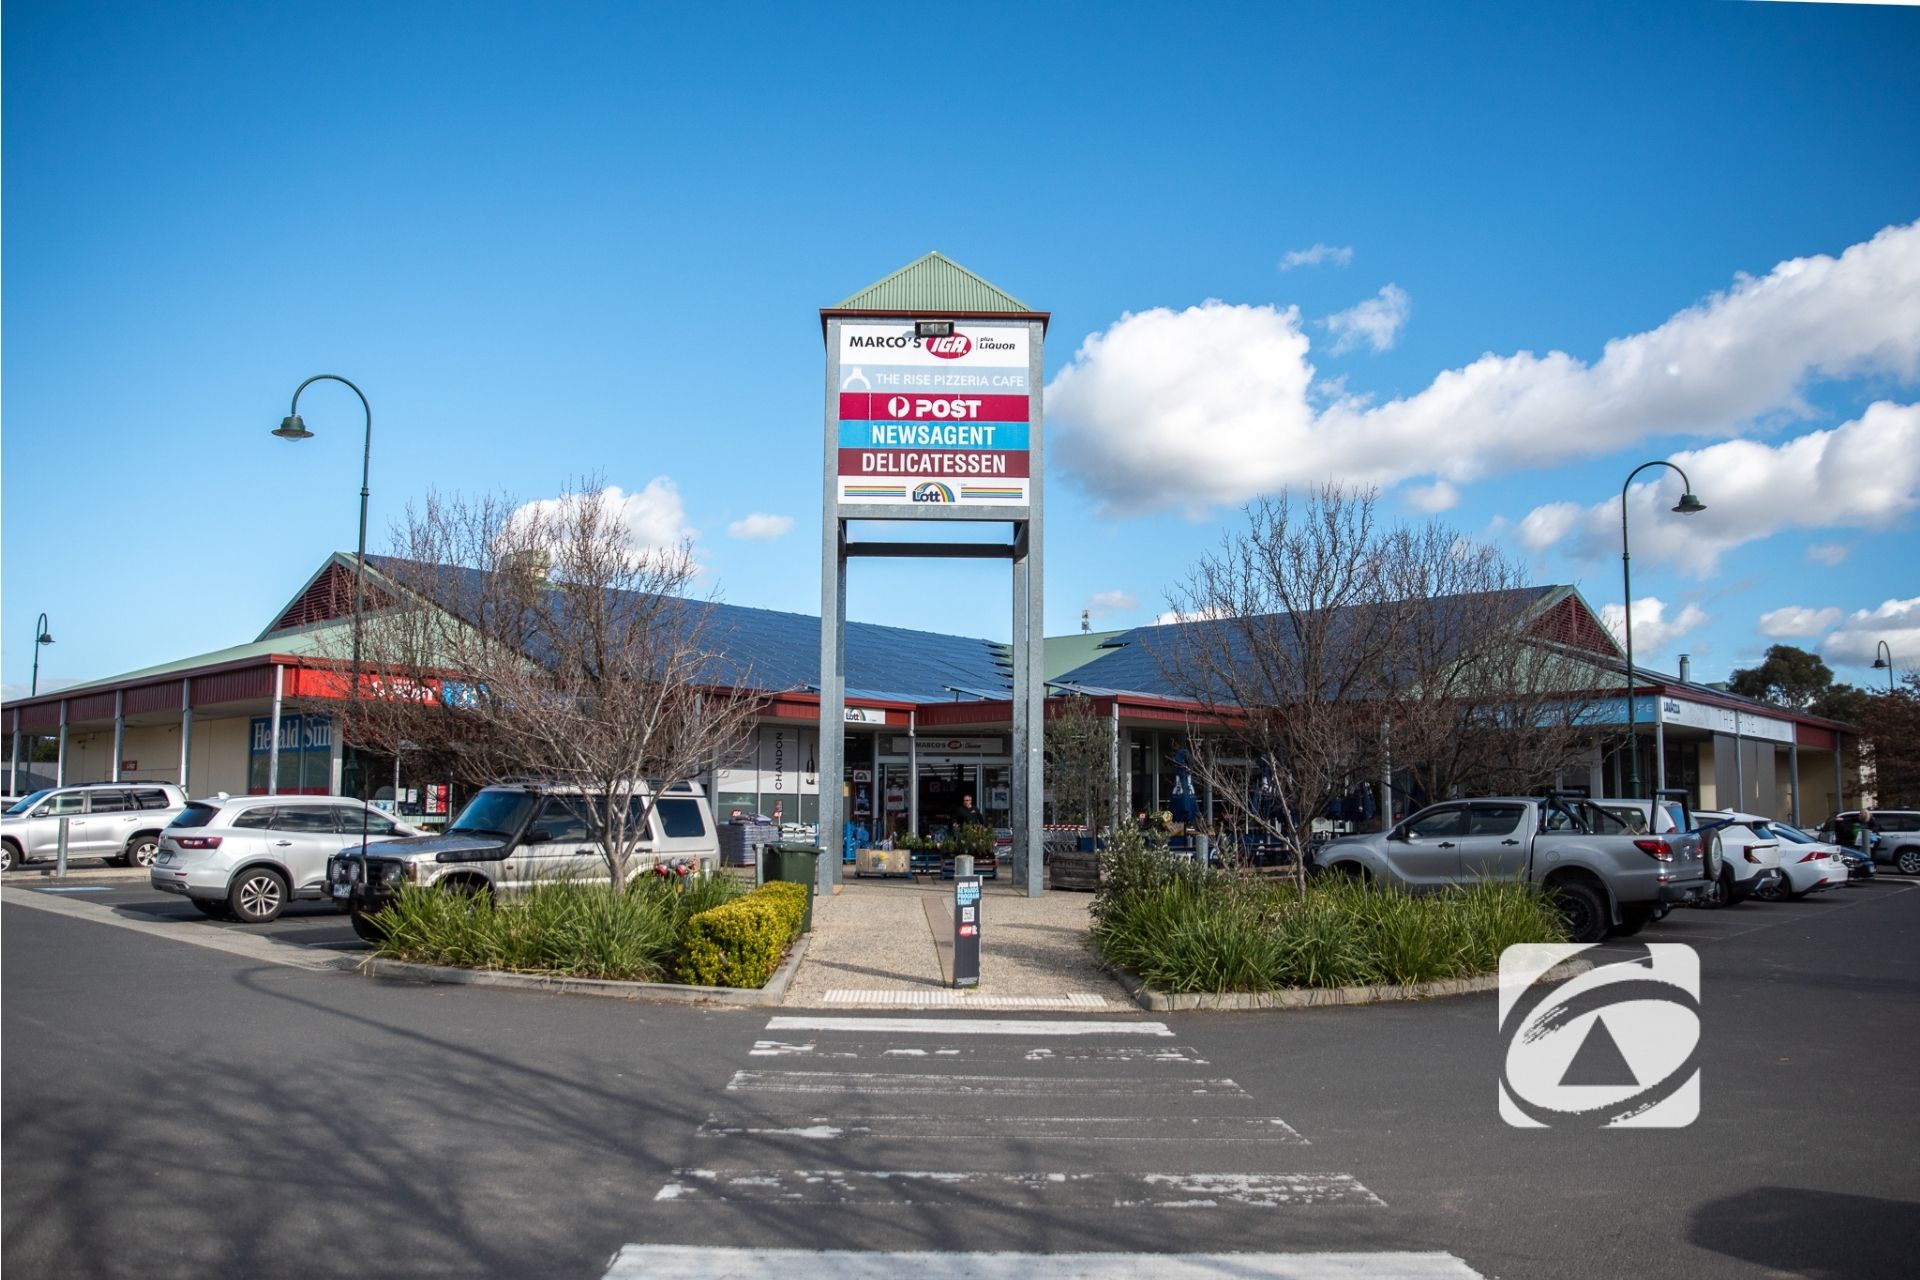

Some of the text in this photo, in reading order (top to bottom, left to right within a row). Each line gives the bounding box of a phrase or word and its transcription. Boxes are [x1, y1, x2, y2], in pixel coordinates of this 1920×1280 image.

[979, 342, 1016, 350] LIQUOR
[875, 373, 1024, 387] THE RISE PIZZERIA CAFE
[915, 399, 982, 419] POST
[872, 425, 996, 446] NEWSAGENT
[862, 452, 1006, 474] DELICATESSEN
[912, 490, 941, 502] Lott
[774, 731, 784, 791] CHANDON
